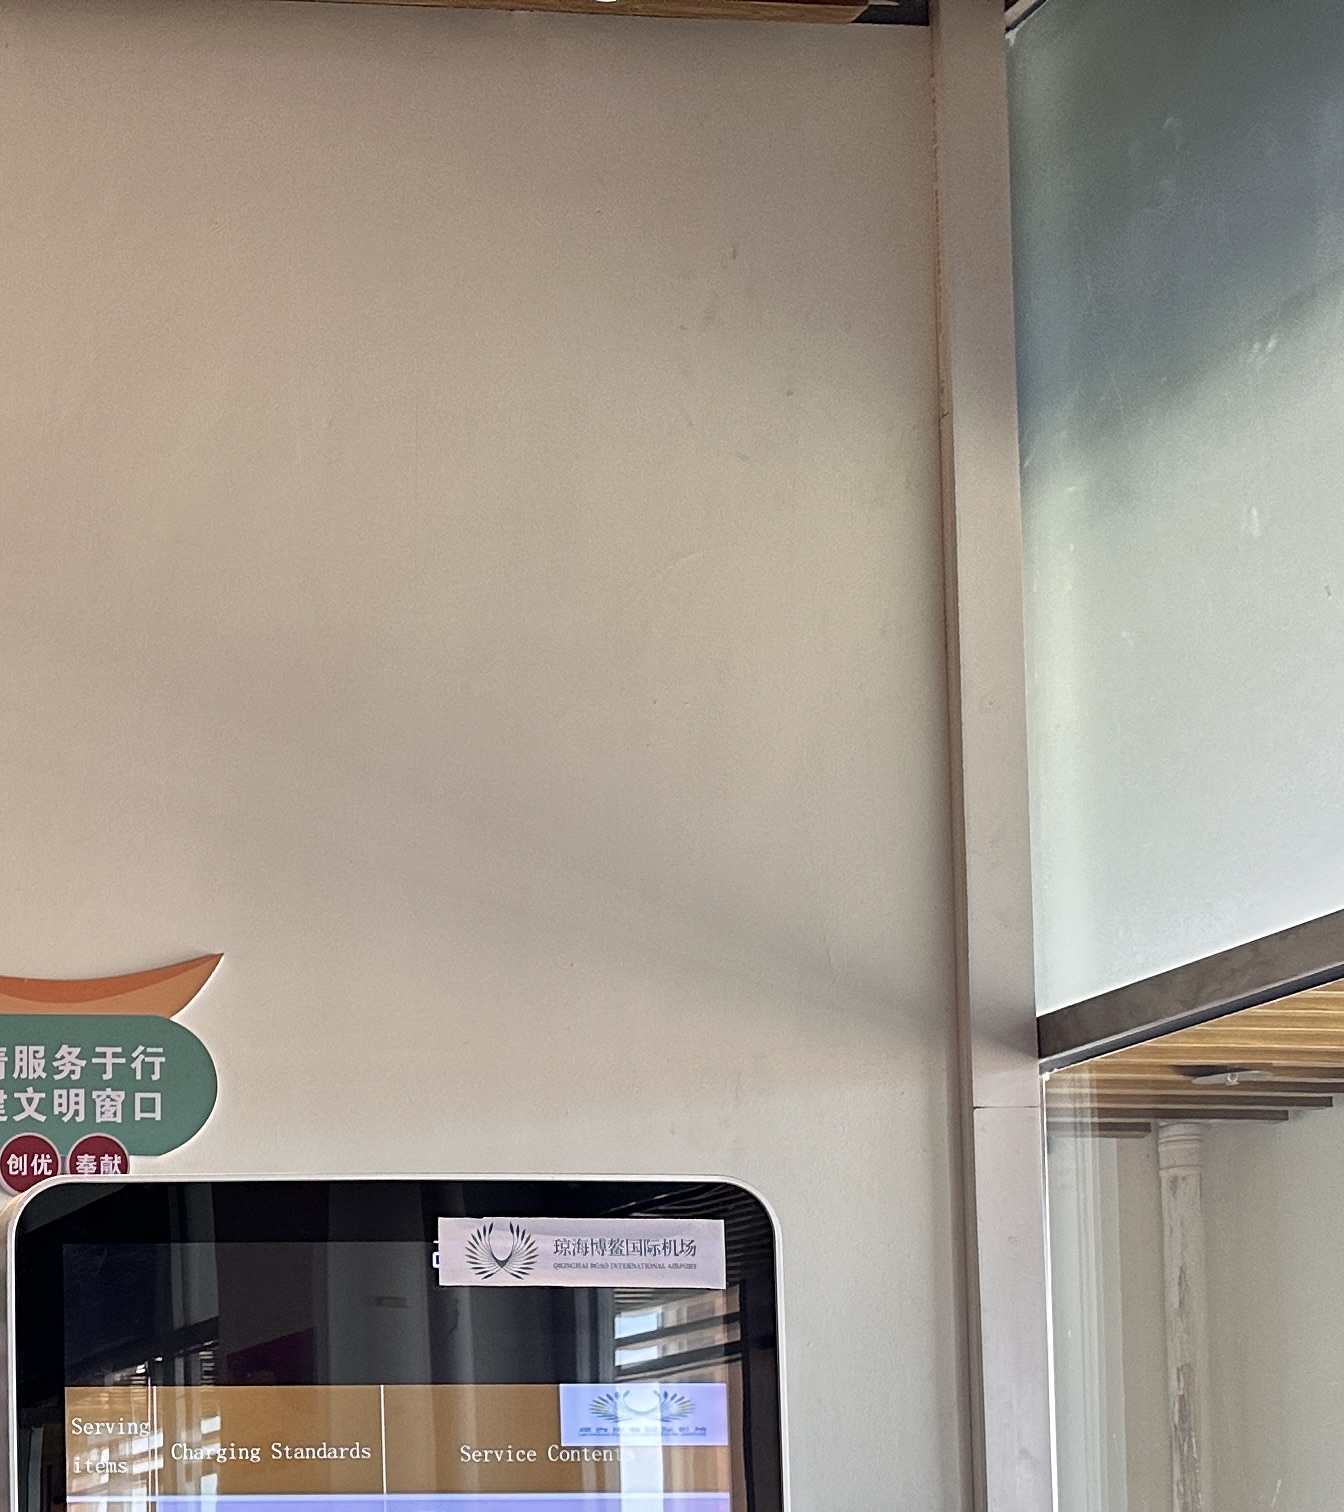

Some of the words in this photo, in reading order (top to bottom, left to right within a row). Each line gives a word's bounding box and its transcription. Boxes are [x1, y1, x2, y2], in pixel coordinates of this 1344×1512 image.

[7, 1154, 52, 1176] 创优
[554, 1238, 697, 1257] 琼海博鳌国际机场
[71, 1417, 152, 1440] Serving
[170, 1442, 262, 1464] Charging
[271, 1440, 372, 1461] Standards
[460, 1443, 537, 1463] Service
[72, 1455, 128, 1475] items
